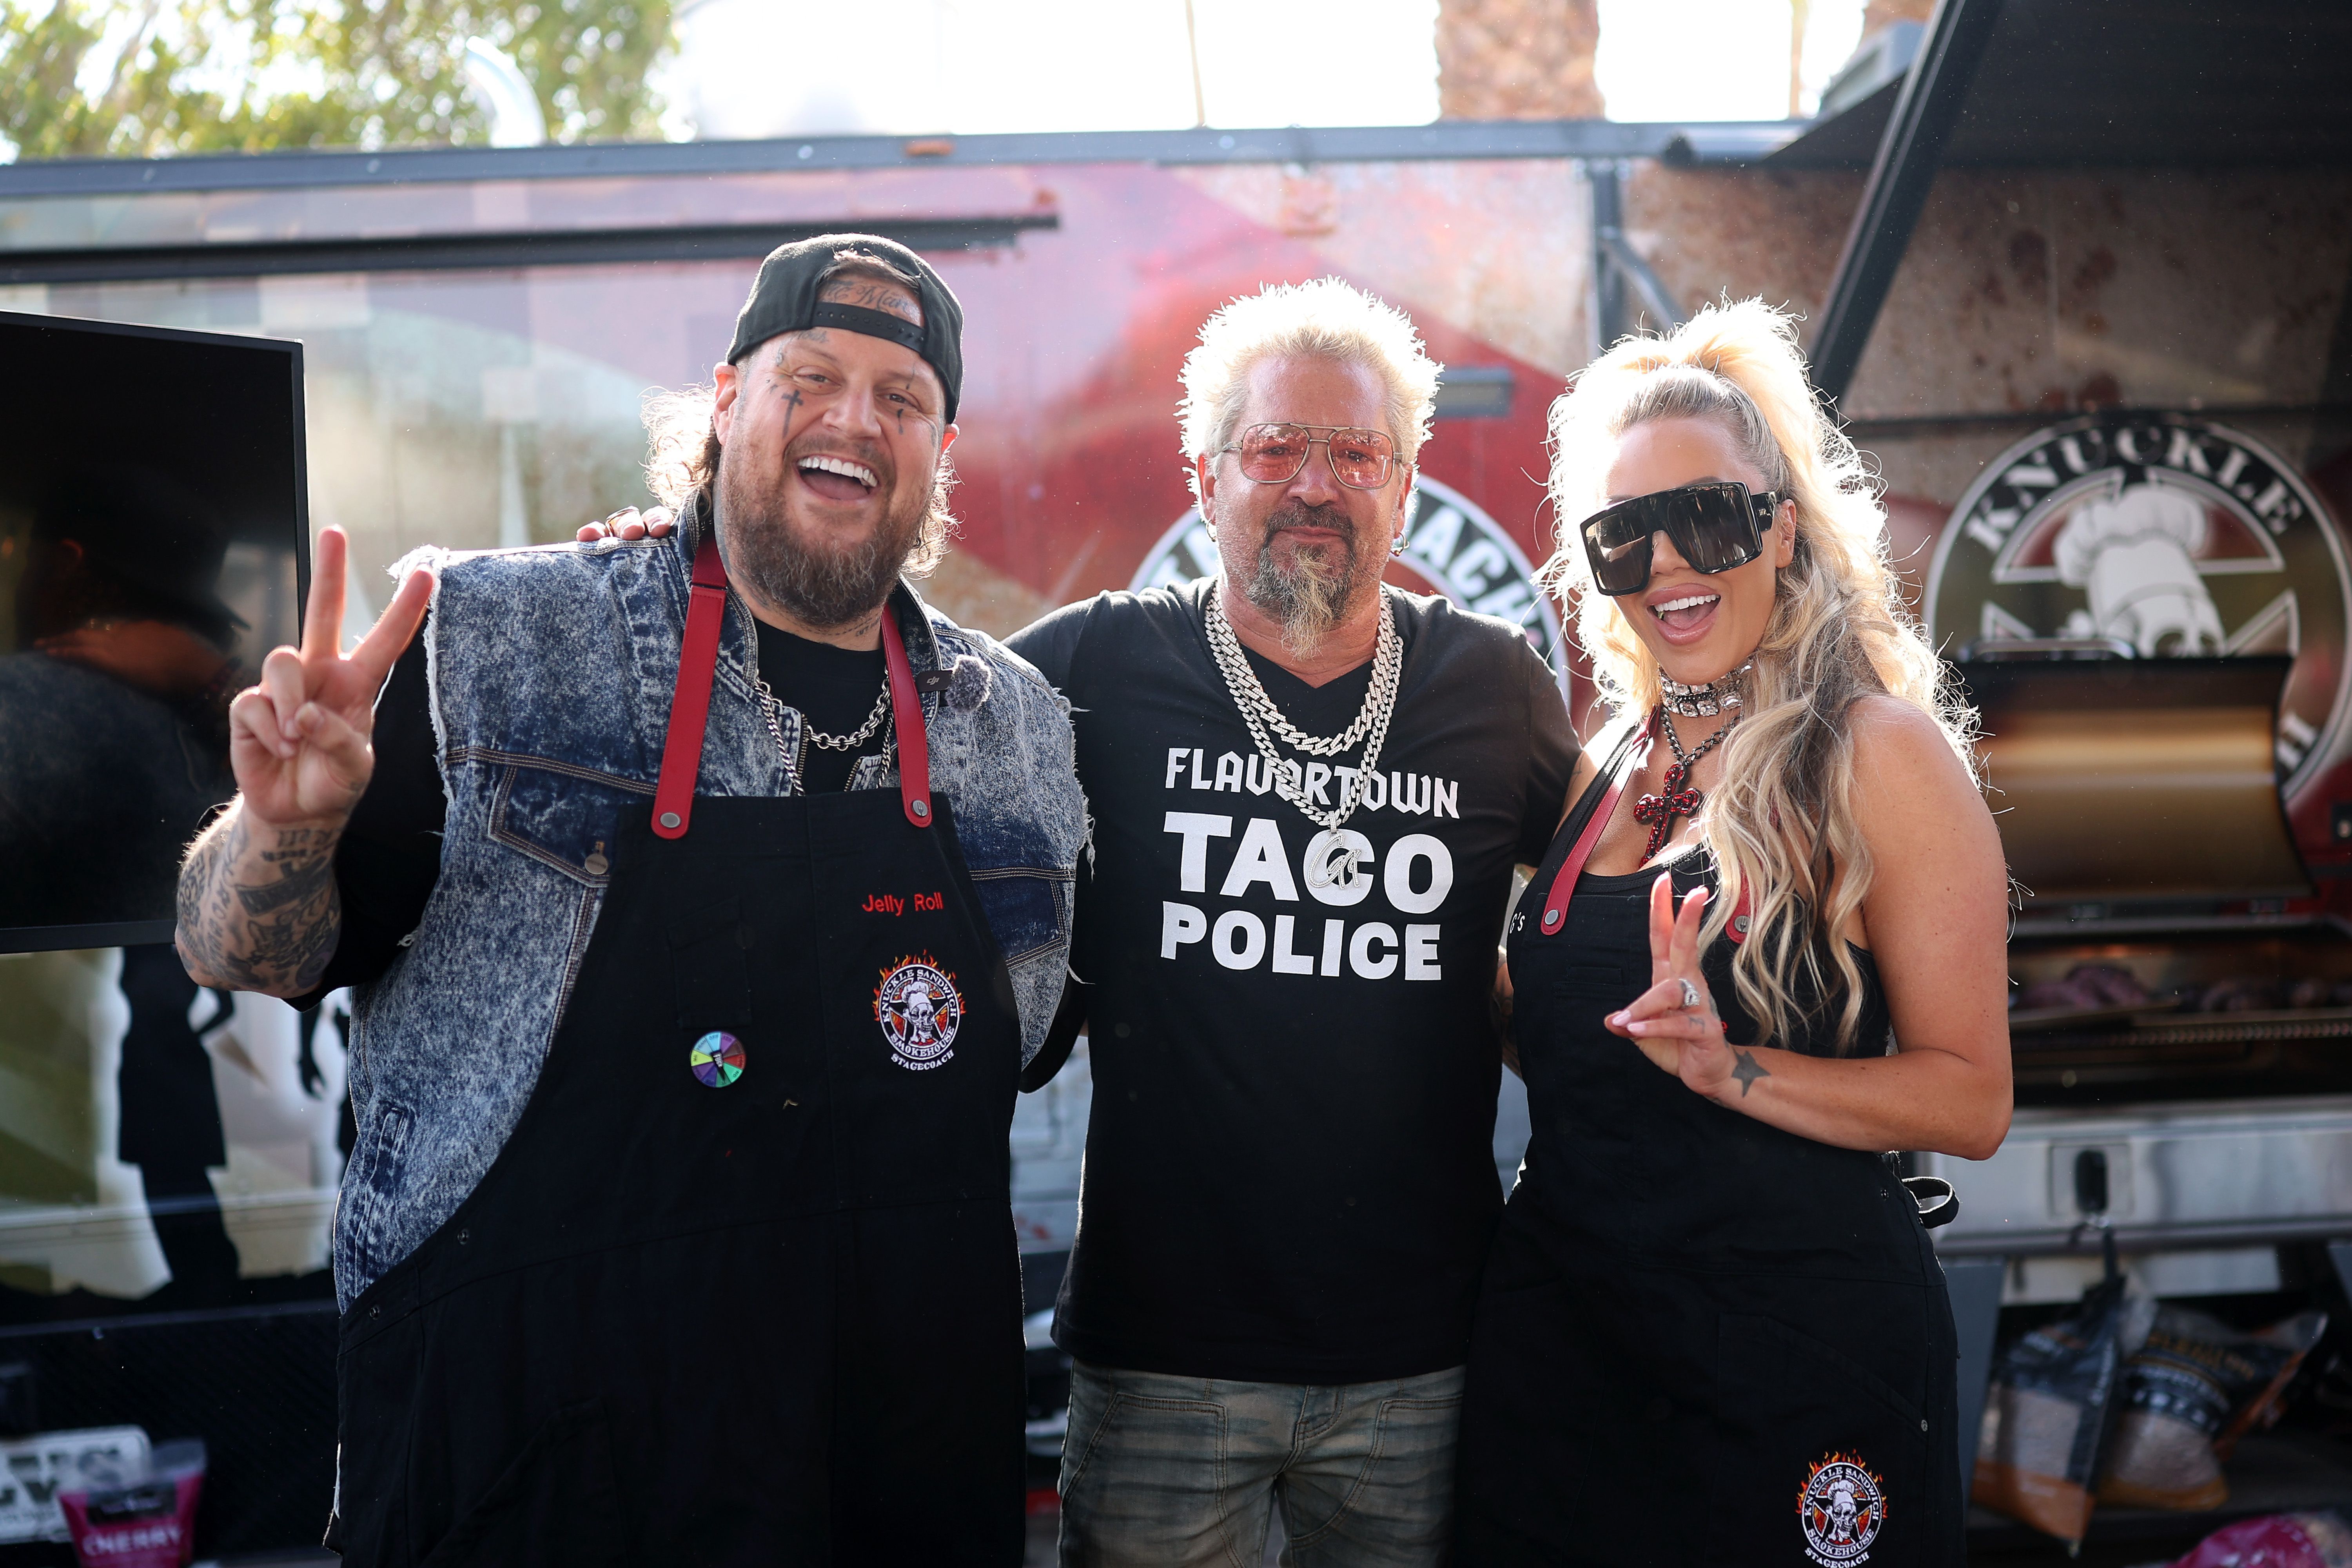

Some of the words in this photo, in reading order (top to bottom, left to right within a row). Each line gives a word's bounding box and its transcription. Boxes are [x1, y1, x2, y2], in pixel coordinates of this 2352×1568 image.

[1968, 425, 2302, 549] KNUCKLE
[1165, 747, 1460, 819] FLAVORTOWN
[1163, 811, 1454, 914] TACO
[862, 894, 904, 916] Jelly
[915, 892, 944, 911] Roll
[1161, 901, 1442, 981] POLICE
[882, 969, 915, 1022] KNUCKLE
[917, 969, 957, 1018] SANDWICH
[890, 1026, 955, 1057] SMOKEHOUSE
[891, 1049, 955, 1071] STAGECOACH
[1805, 1467, 1843, 1517] KNUCKLE
[1845, 1467, 1879, 1521] SANDWICH
[1805, 1547, 1870, 1568] STAGECOACH
[1808, 1528, 1874, 1556] SMOKEHOUSE
